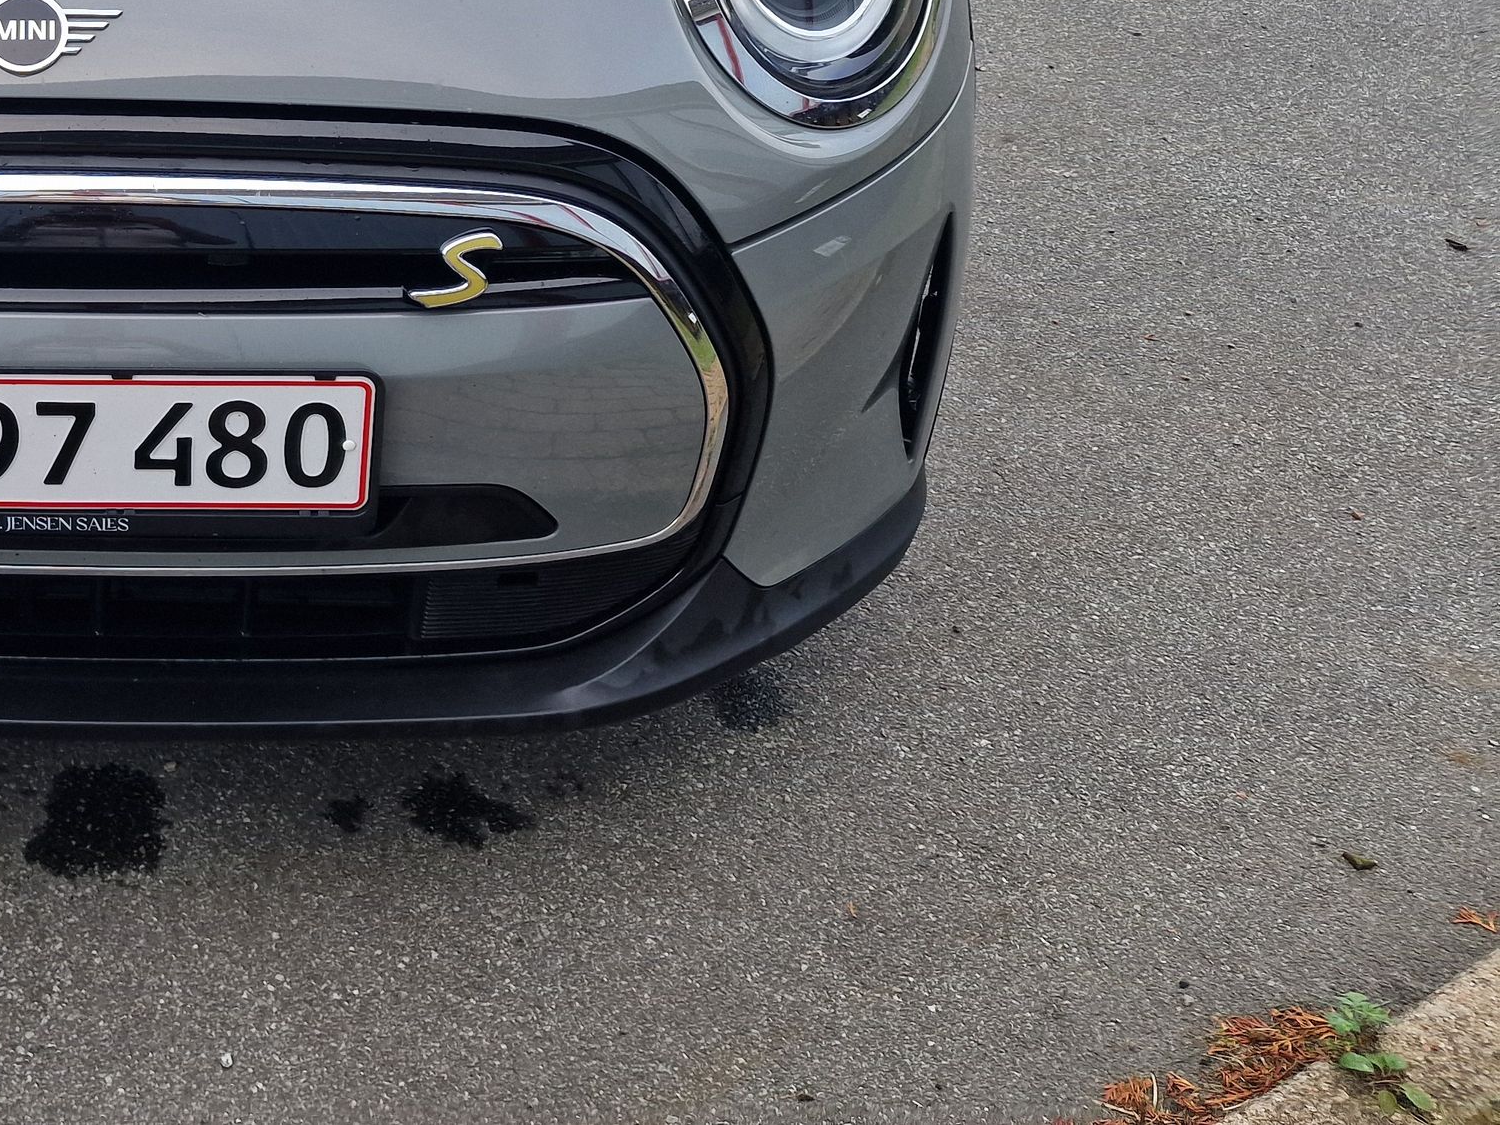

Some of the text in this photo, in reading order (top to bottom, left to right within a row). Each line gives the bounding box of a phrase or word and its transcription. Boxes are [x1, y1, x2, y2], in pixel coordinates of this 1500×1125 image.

[408, 227, 504, 309] S
[134, 400, 347, 488] 480
[4, 516, 72, 532] JENSEN
[76, 517, 130, 532] SALES
